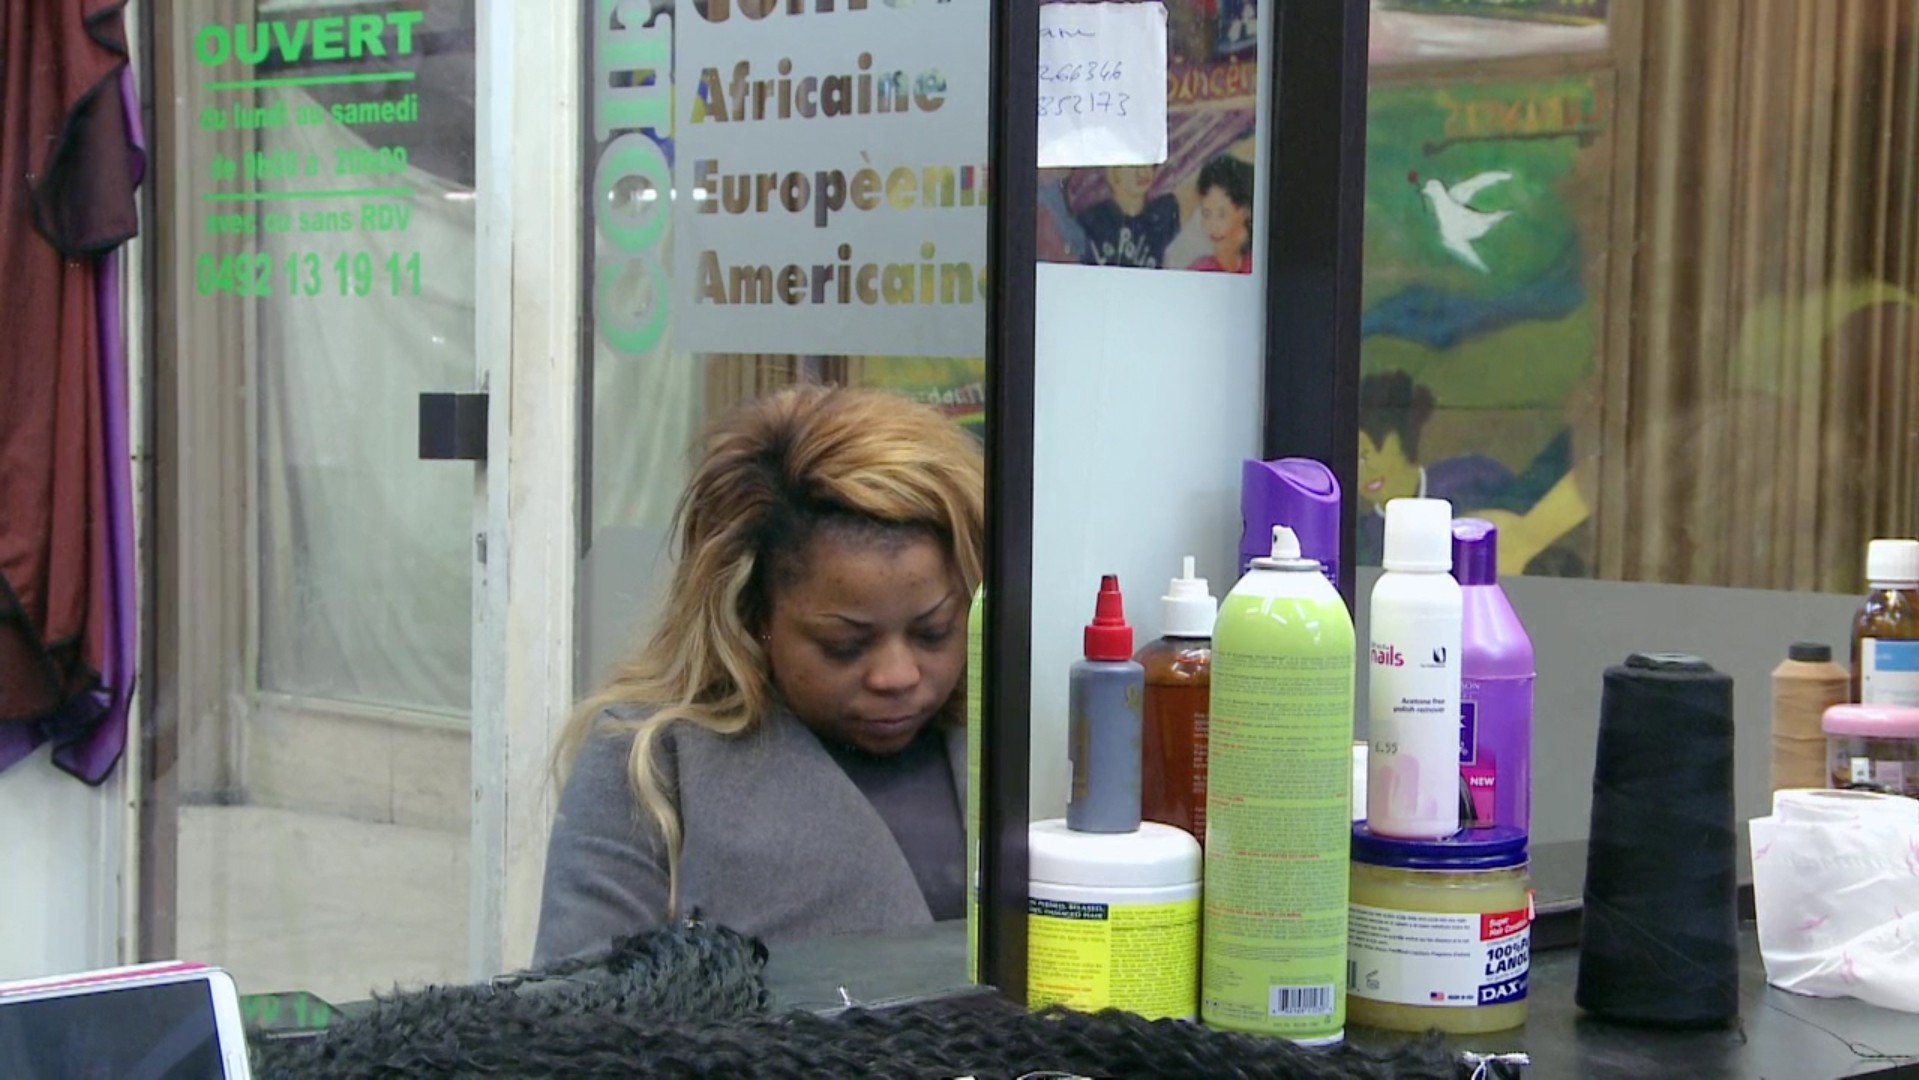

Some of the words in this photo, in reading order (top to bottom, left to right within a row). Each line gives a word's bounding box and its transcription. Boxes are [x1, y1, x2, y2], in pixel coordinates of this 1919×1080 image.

[194, 11, 423, 67] OUVERT
[1040, 61, 1123, 82] 266346
[690, 52, 947, 123] Africaine
[200, 104, 227, 130] du
[234, 99, 288, 128] lundi
[296, 105, 325, 125] au
[331, 94, 419, 125] samedi
[209, 154, 236, 180] de
[205, 213, 256, 235] avec
[263, 212, 292, 234] ou
[298, 210, 353, 233] sans
[360, 203, 413, 231] RDV
[196, 252, 273, 298] 0492
[285, 251, 322, 297] 13
[334, 251, 373, 297] 19
[385, 250, 421, 297] 11
[1402, 696, 1431, 705] Acetone
[1470, 777, 1495, 786] NEW
[1481, 980, 1518, 1002] DAX
